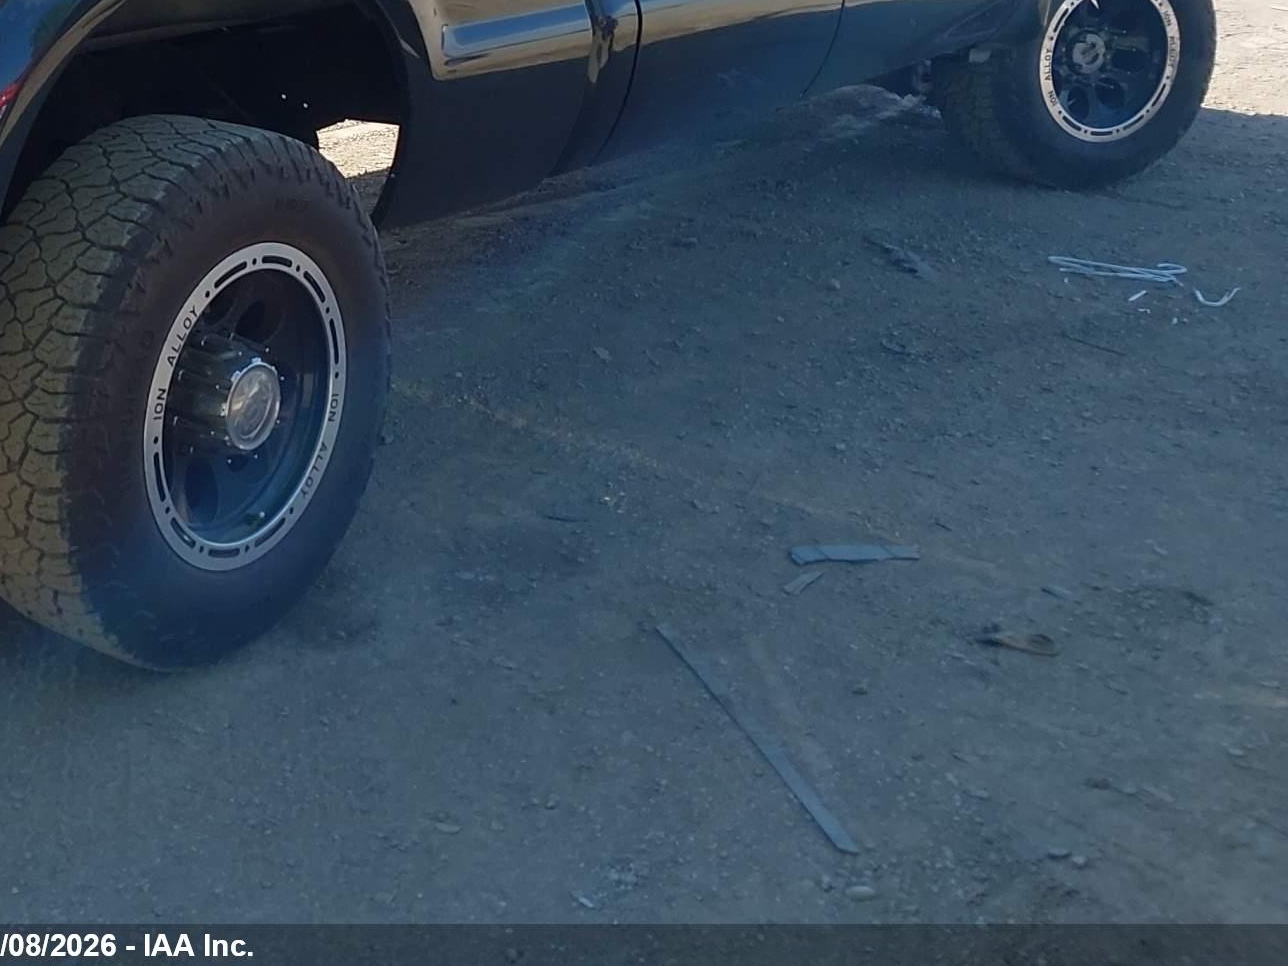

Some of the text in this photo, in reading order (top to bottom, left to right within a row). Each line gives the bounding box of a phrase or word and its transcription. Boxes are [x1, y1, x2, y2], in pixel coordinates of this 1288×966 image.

[153, 305, 198, 420] ION ALLOY
[300, 393, 339, 499] ION ALLOY
